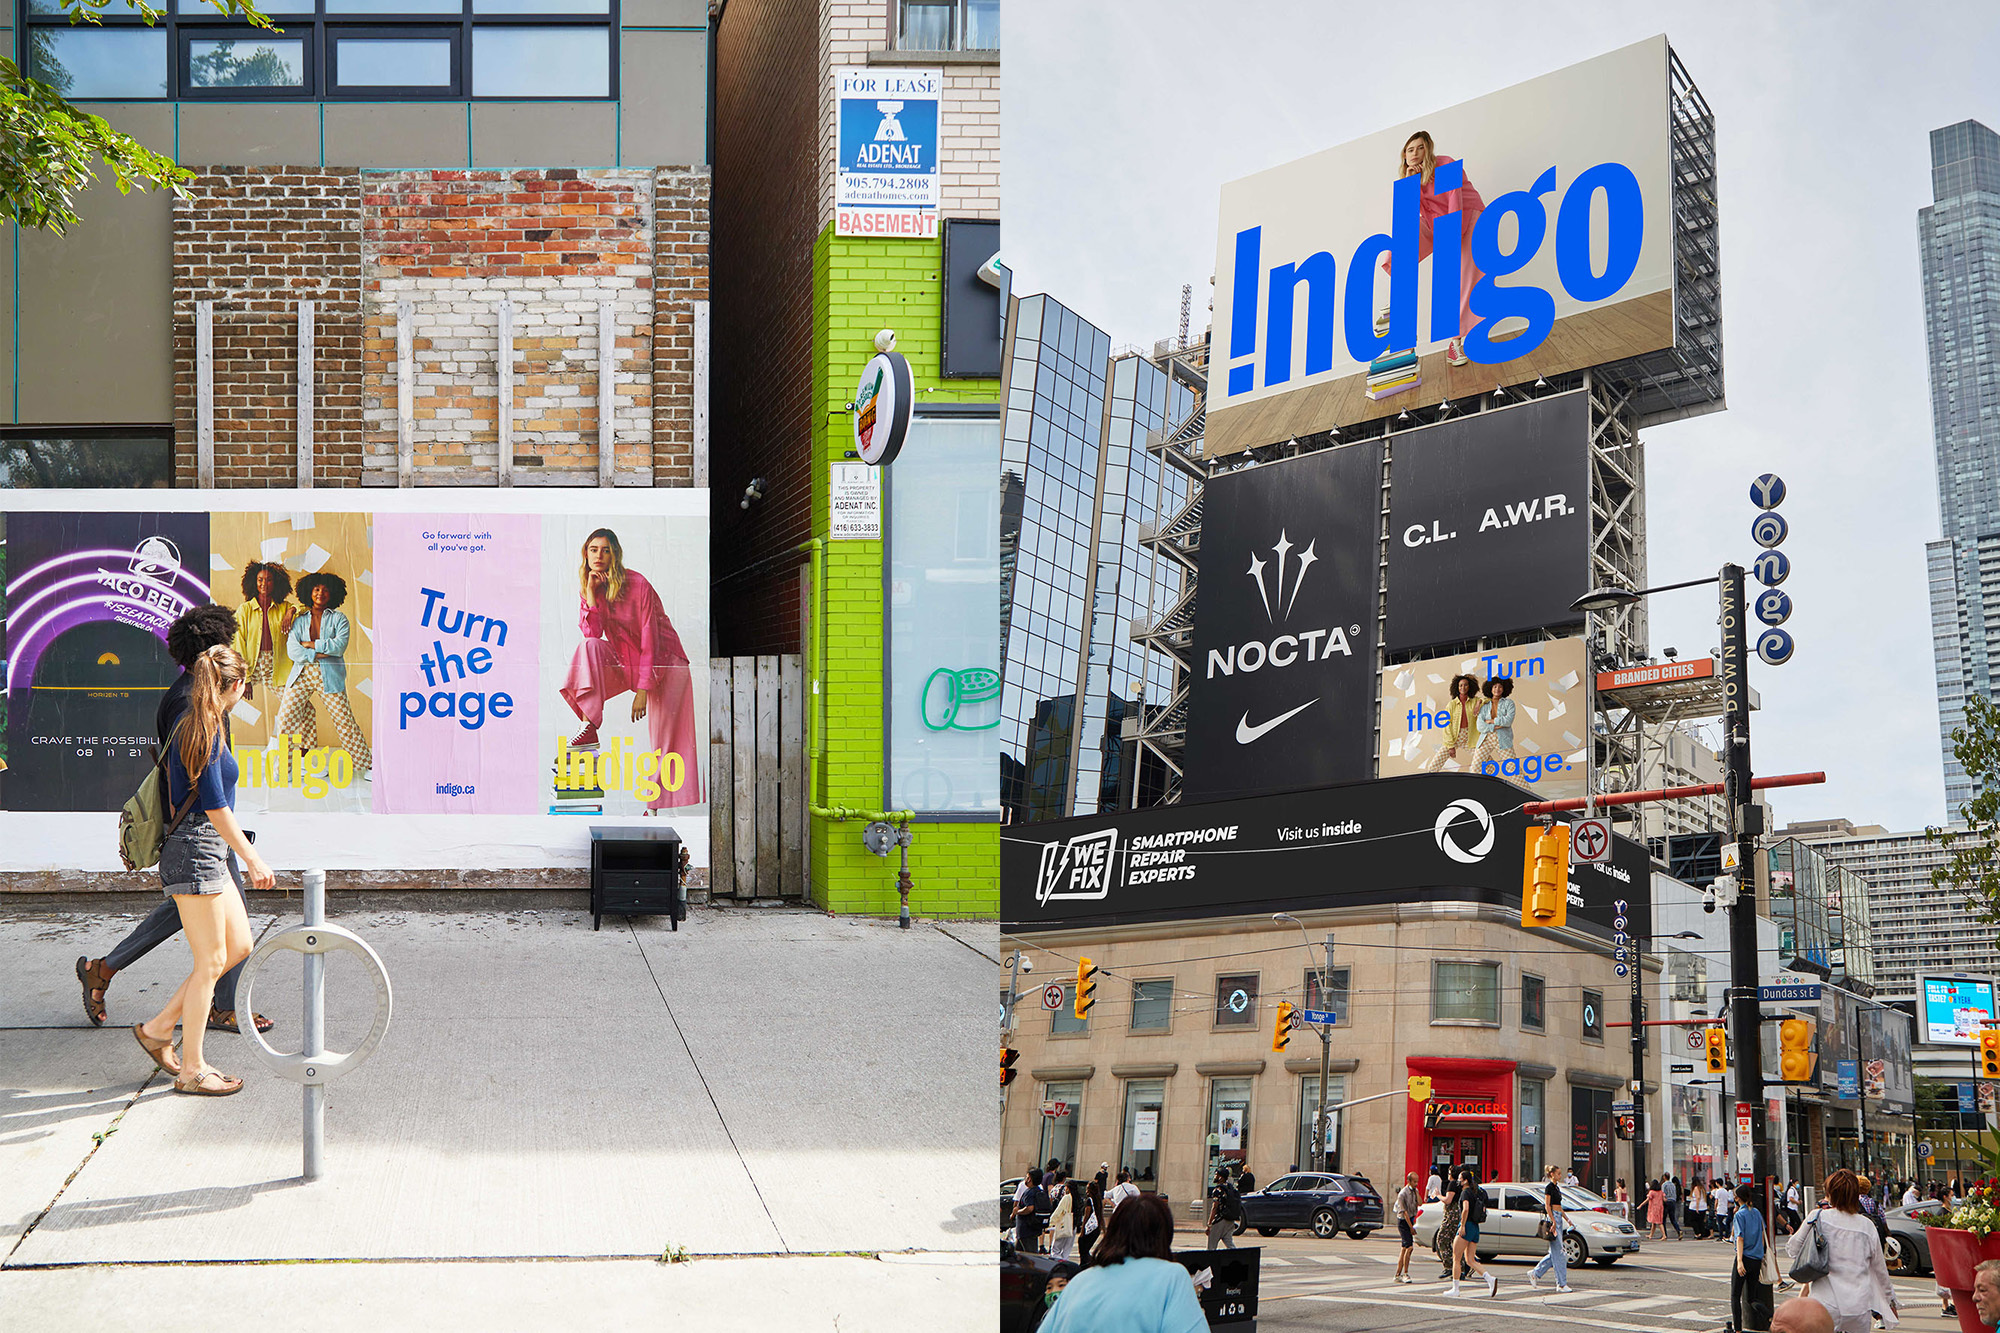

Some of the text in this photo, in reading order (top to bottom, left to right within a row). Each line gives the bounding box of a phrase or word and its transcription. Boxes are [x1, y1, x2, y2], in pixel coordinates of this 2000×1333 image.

[843, 79, 937, 93] FOR LEASE
[857, 143, 922, 164] ADENAT
[846, 177, 929, 190] 905.794.2808
[845, 190, 929, 200] adenathomes.com
[839, 213, 936, 234] BASEMENT
[1228, 158, 1644, 397] Indigo
[835, 502, 878, 510] ADENAT INC.
[834, 524, 849, 532] (416)
[1402, 493, 1575, 548] C.L. A.W.R.
[422, 530, 492, 541] Go forward with
[428, 543, 486, 554] all you've got.
[98, 567, 144, 599] TACO
[420, 587, 508, 647] Turn
[1722, 579, 1738, 712] DOWNTOWN
[420, 640, 493, 688] the
[1481, 654, 1544, 682] Turn
[1614, 663, 1694, 686] BRANDED CITIES
[400, 691, 514, 730] page
[1406, 702, 1451, 732] the
[31, 736, 72, 745] CRAVE
[76, 736, 99, 745] THE
[76, 749, 142, 757] 08 11 21
[230, 733, 353, 800] ndigo
[558, 736, 686, 802] Indigo
[1481, 753, 1572, 783] page.
[436, 782, 475, 796] indigo.ca
[1131, 825, 1238, 851] SMARTPHONE
[1277, 820, 1362, 842] Visit us inside
[1073, 841, 1107, 867] WE
[1130, 849, 1186, 868] REPAIR
[1069, 866, 1104, 890] FIX
[1128, 865, 1196, 886] EXPERTS
[1612, 864, 1631, 884] inside
[1763, 987, 1814, 999] Dundas St E
[1311, 1012, 1325, 1023] Yonge
[1456, 1103, 1508, 1114] ROGERS
[1491, 1123, 1507, 1132] 302
[1597, 1140, 1607, 1155] 5G
